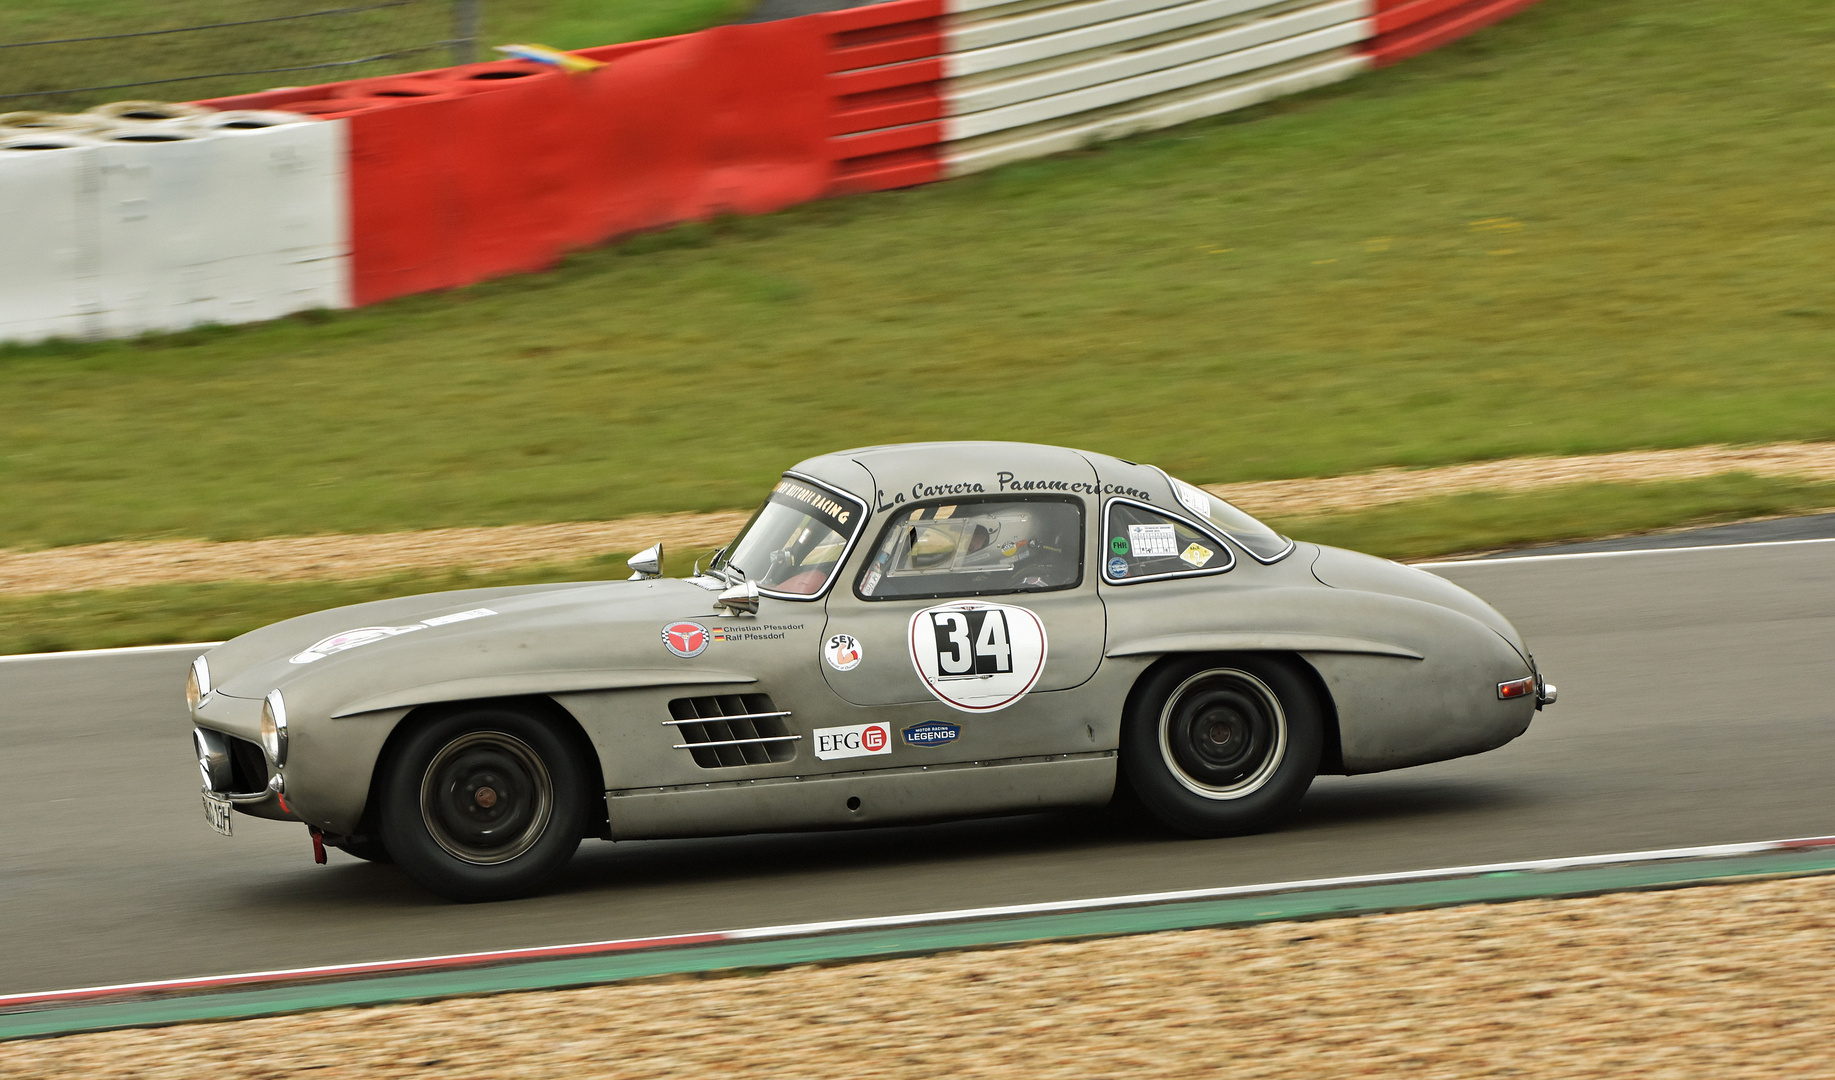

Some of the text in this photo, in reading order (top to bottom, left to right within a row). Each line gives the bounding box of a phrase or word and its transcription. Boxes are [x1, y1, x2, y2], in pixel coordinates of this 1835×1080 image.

[877, 471, 1152, 513] La Carrera Panamericana
[810, 494, 850, 525] RACING
[1113, 541, 1128, 549] FHR
[723, 623, 804, 633] Christian Pfessdorf
[725, 632, 785, 642] Ralf Pfessdorf
[831, 635, 855, 650] SEX
[934, 610, 1010, 674] 34
[819, 732, 860, 753] EFG
[908, 730, 956, 741] LEGENDS
